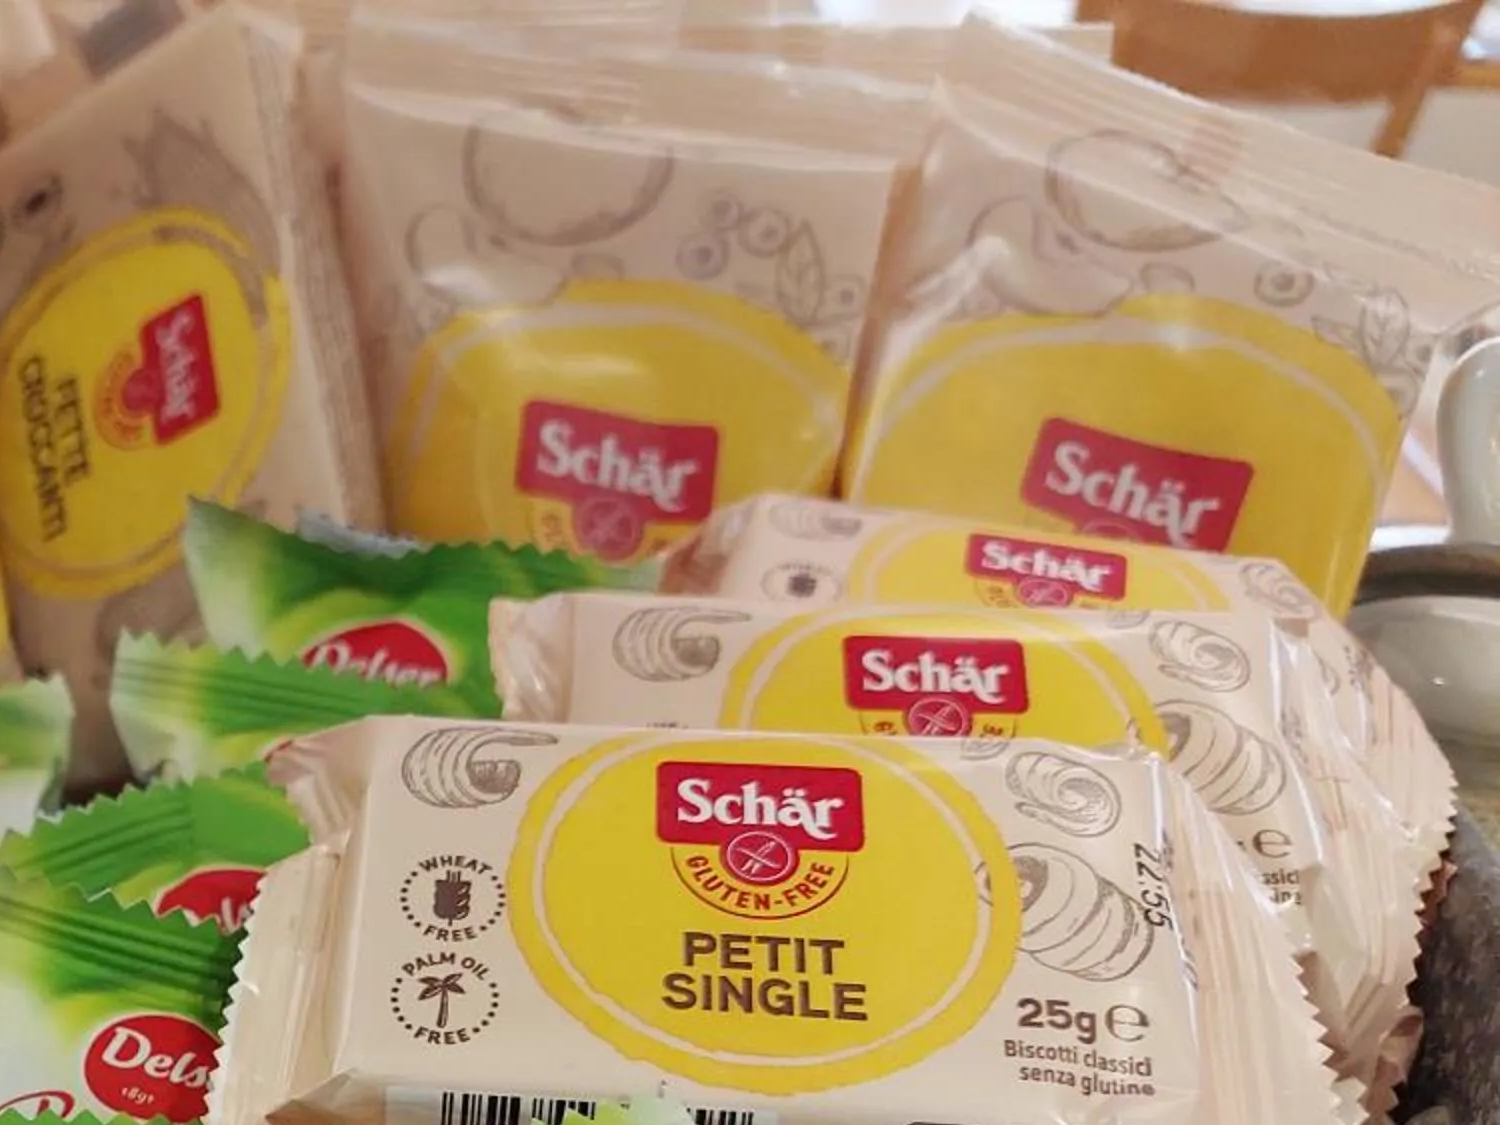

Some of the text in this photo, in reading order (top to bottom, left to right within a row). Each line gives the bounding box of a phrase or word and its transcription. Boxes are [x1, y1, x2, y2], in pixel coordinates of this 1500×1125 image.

[56, 377, 89, 487] FETTE
[535, 417, 702, 514] Schär
[1044, 440, 1221, 551] Schär
[981, 539, 1114, 592] Schär
[860, 648, 1011, 706] Schär
[676, 777, 845, 841] Schär
[418, 855, 494, 875] WHEAT
[685, 854, 837, 912] GLUTEN-FREE
[422, 923, 478, 943] FREE
[682, 931, 845, 975] PETIT
[401, 951, 491, 981] PALM OIL
[661, 972, 869, 1022] SINGLE
[1016, 996, 1098, 1045] 25g
[100, 1026, 211, 1090] Dels
[413, 1025, 471, 1046] FREE
[1003, 1039, 1153, 1077] Biscotti classici
[1018, 1065, 1156, 1098] senza glutine
